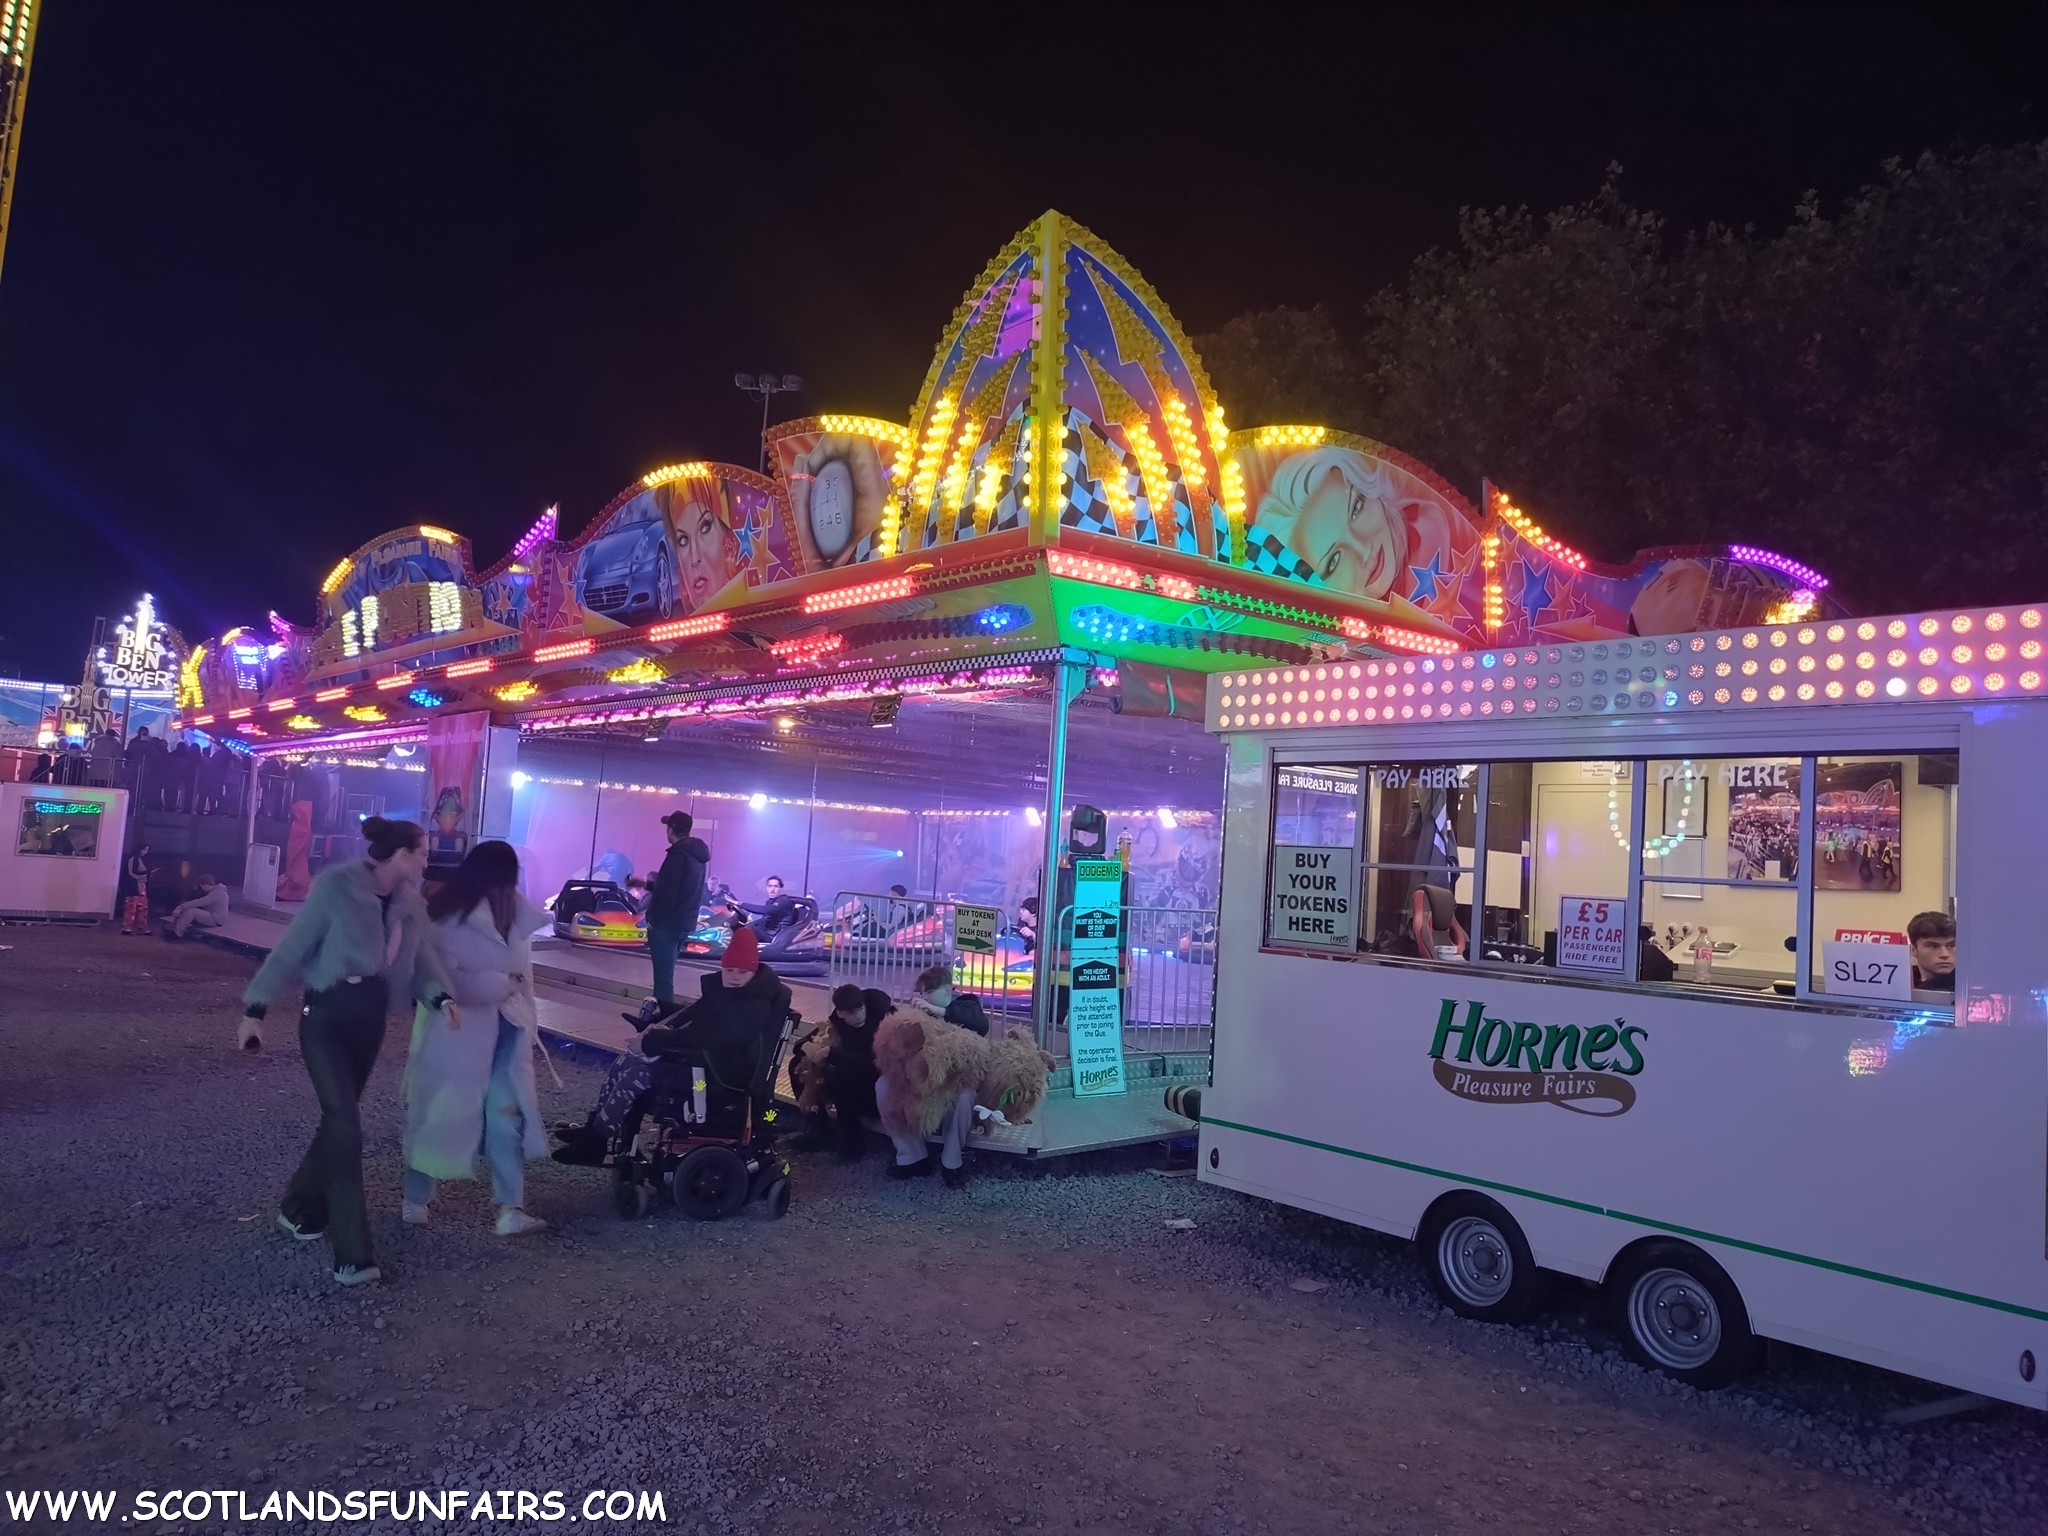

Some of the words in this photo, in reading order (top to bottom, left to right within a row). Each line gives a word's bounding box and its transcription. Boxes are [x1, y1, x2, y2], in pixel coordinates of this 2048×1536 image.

[116, 646, 161, 672] BEN
[102, 663, 170, 690] TOWER
[62, 685, 112, 711] BIG
[1375, 768, 1412, 789] PAY
[1657, 763, 1708, 787] PAY
[1717, 762, 1789, 787] HERE
[1295, 853, 1331, 869] BUY
[1288, 873, 1337, 891] YOUR
[1277, 894, 1348, 914] TOKENS
[1577, 901, 1610, 924] £5
[970, 910, 994, 920] TOKENS
[960, 928, 976, 936] CASH
[1288, 916, 1335, 935] HERE
[1563, 925, 1590, 941] PER
[1595, 927, 1623, 944] CAR
[1840, 931, 1891, 944] PRICE
[1563, 942, 1622, 954] PASSENGERS
[1565, 952, 1588, 961] RIDE
[1592, 954, 1619, 964] FREE
[1834, 960, 1899, 985] SL27
[1088, 1004, 1106, 1012] height
[1076, 1022, 1090, 1030] prior
[1098, 1022, 1114, 1030] joining
[1450, 1072, 1532, 1097] Pleasure
[1542, 1074, 1597, 1097] Fairs
